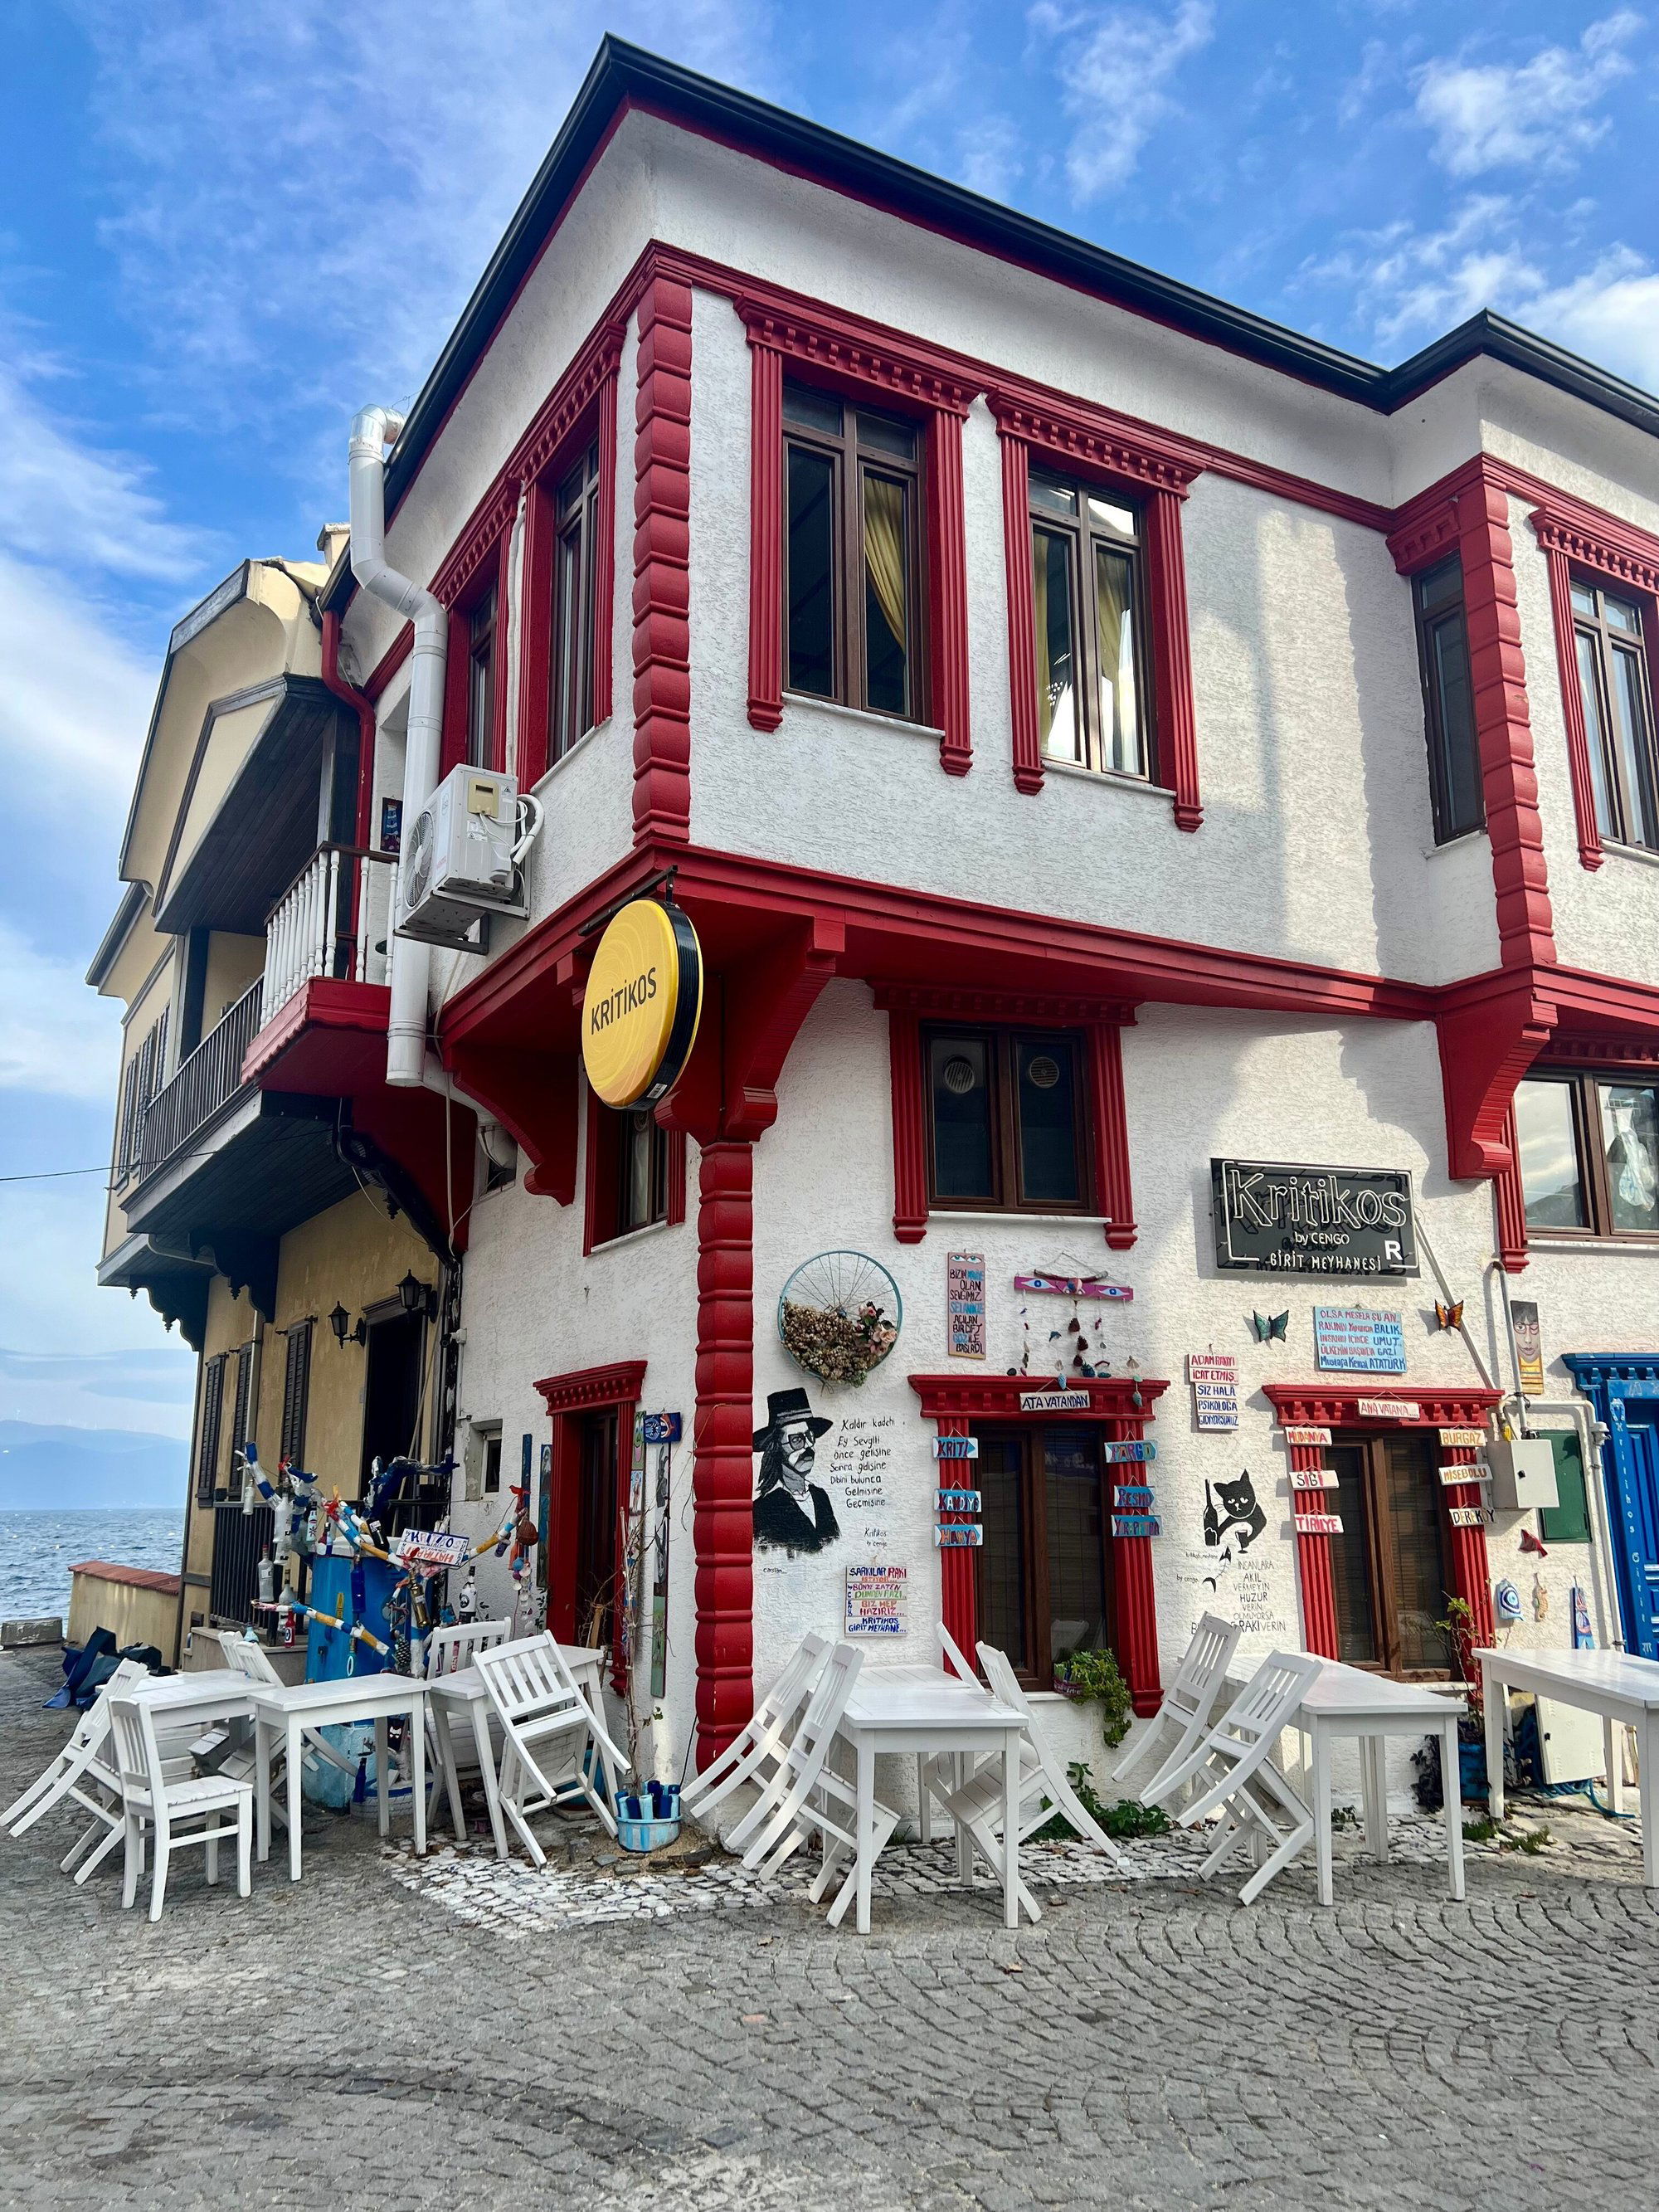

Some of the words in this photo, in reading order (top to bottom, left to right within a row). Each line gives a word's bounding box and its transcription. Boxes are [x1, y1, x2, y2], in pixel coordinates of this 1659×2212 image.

[591, 967, 657, 1035] KRİTİKOS
[1229, 1169, 1409, 1229] Kritikos
[1294, 1231, 1308, 1245] by
[1311, 1232, 1350, 1245] CENGO
[1384, 1240, 1402, 1260] R
[1321, 1310, 1343, 1318] OLSA
[1191, 1355, 1215, 1366] ADAM
[1022, 1396, 1044, 1409] ATA
[837, 1436, 848, 1447] Ey
[1288, 1431, 1327, 1443] MUDANYA
[1443, 1431, 1481, 1444] BURGAZ
[940, 1528, 978, 1546] HANYA
[1239, 1592, 1267, 1603] HUZUR
[1238, 1620, 1260, 1633] RAKI
